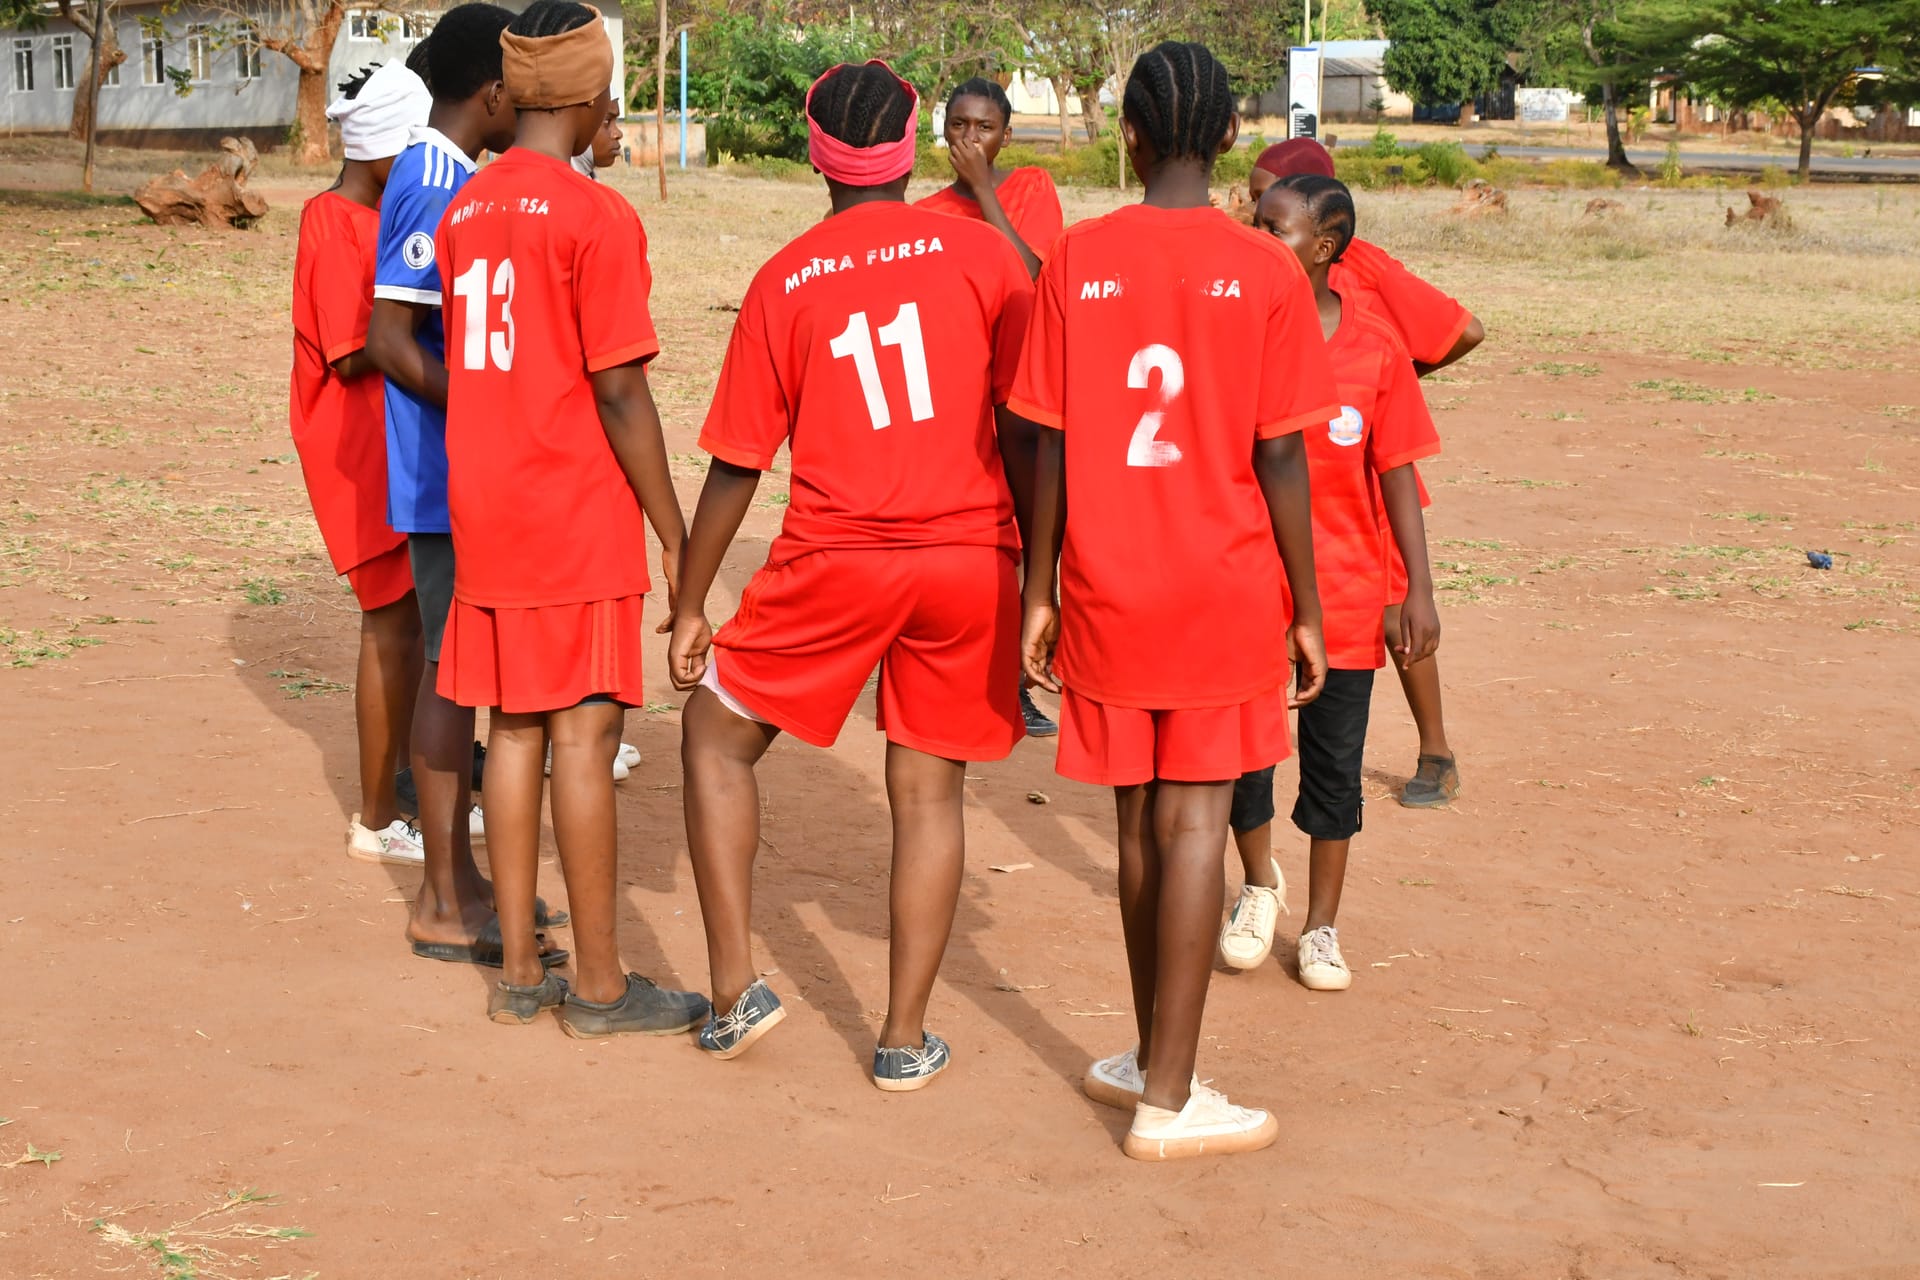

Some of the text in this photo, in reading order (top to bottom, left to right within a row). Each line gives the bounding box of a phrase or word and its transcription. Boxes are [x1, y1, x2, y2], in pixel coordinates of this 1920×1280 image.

[866, 236, 944, 265] FURSA
[453, 258, 516, 372] 13
[829, 301, 935, 431] 11
[1126, 343, 1185, 467] 2
